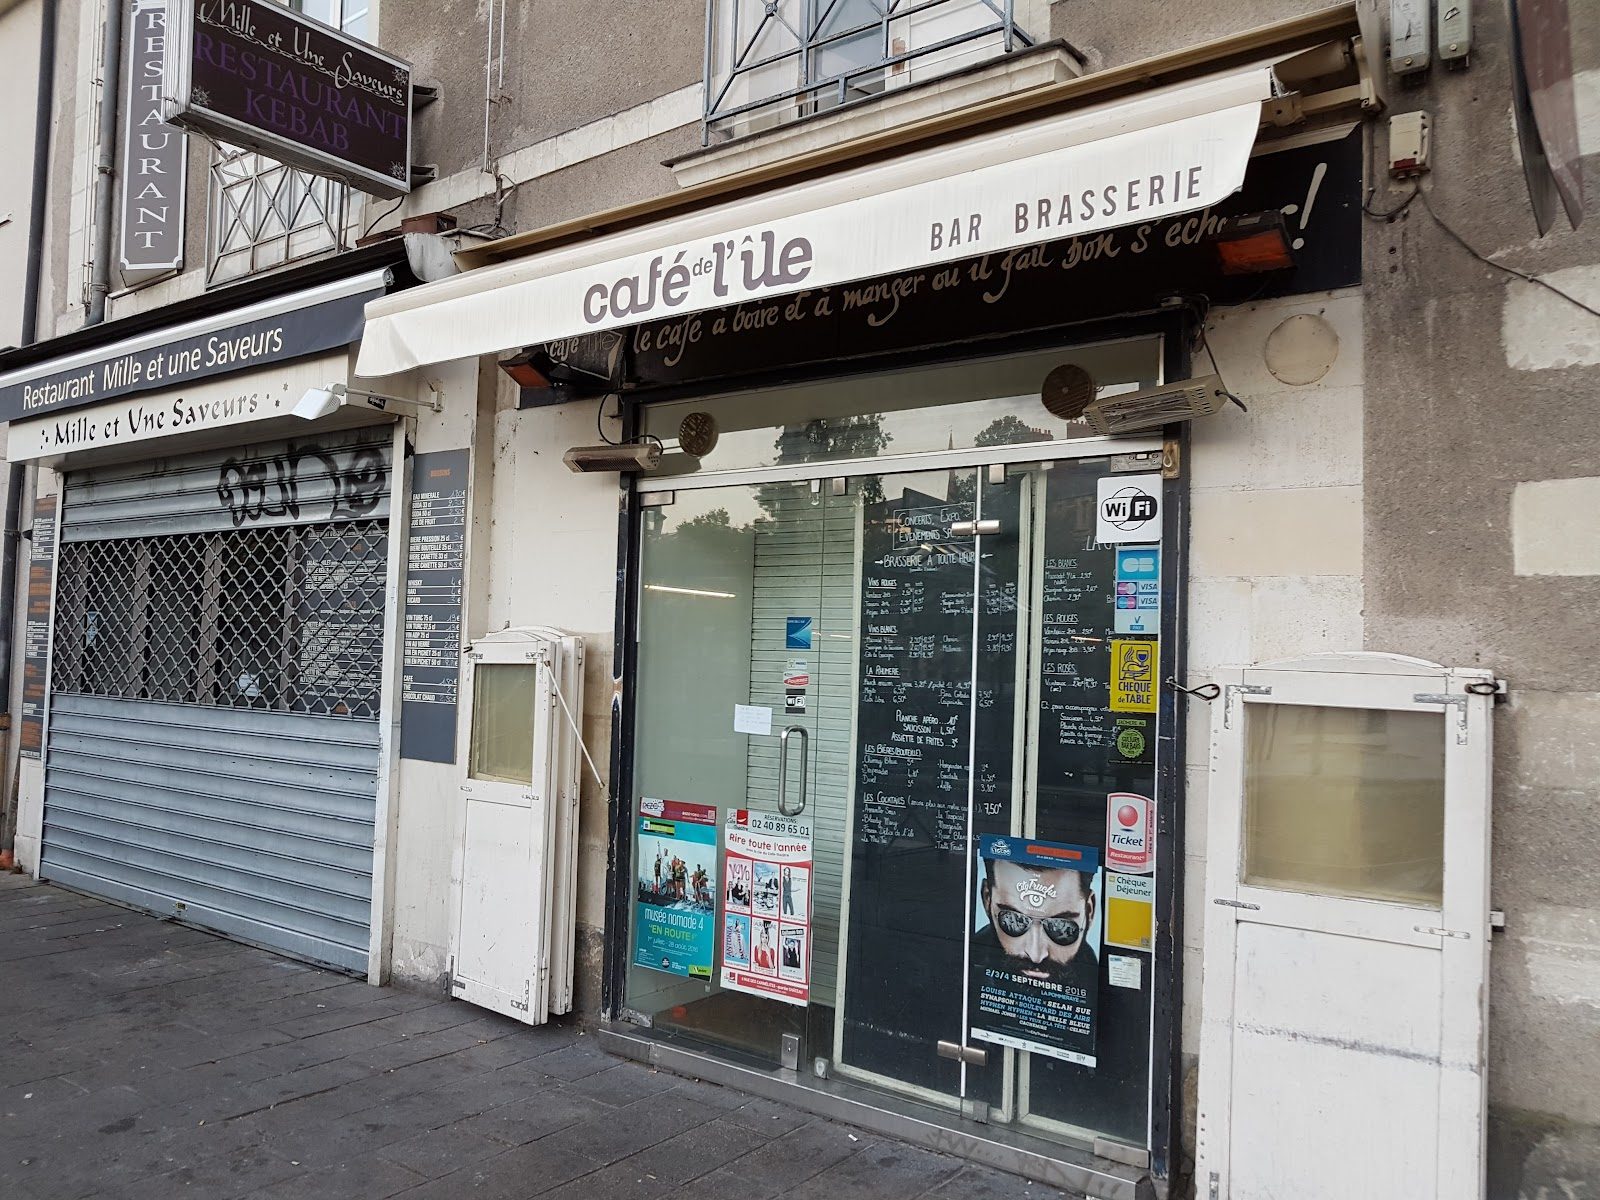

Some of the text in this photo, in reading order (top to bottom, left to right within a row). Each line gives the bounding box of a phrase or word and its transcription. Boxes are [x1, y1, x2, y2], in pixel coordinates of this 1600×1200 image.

[200, 0, 403, 99] Mille et Une Saveurs
[194, 31, 406, 140] RESTAURANT
[244, 87, 349, 150] KEBAB
[134, 13, 171, 249] RESTAURANT
[930, 166, 1202, 251] BAR BRASSERIE
[583, 250, 691, 324] café
[692, 257, 713, 276] de
[633, 325, 651, 354] le
[732, 300, 779, 332] boire
[785, 291, 812, 321] et
[843, 274, 925, 326] manger
[983, 243, 1054, 304] fait
[1062, 233, 1121, 270] bon
[23, 327, 283, 410] Restaurant Mille et une Saveurs
[54, 393, 258, 447] Mille et Une Saveurs
[884, 551, 976, 568] BRASSERIE A TOUTE HEUR
[1141, 583, 1158, 591] VISA
[1141, 597, 1158, 605] VISA
[1118, 682, 1152, 693] CHEQUE
[1125, 694, 1152, 704] TABLE
[896, 709, 918, 723] PLANCHE
[903, 723, 932, 734] SAUCISSON
[891, 732, 915, 743] ASSIETTE
[917, 736, 924, 744] DE
[926, 737, 945, 747] FRITES
[864, 744, 875, 753] LES
[864, 792, 874, 802] LES
[752, 819, 810, 836] 02 40 89 65 01
[730, 833, 807, 852] Rire toute l'année
[1112, 833, 1144, 847] Ticket
[1016, 878, 1057, 898] City Trucks
[1116, 875, 1147, 888] Chèque
[1116, 885, 1152, 897] Déjeuner
[644, 907, 704, 932] musée nomade 4
[664, 928, 691, 941] ROUTE
[985, 969, 1087, 997] 2/3/4 SEPTEMBRE 2016
[981, 986, 1092, 1016] LOUISE ATTAQUE SELAH SUE
[1018, 1002, 1057, 1016] BOULEVARD
[1058, 1010, 1073, 1019] DES
[1036, 1012, 1046, 1020] LA
[1048, 1015, 1068, 1025] BELLE
[1069, 1020, 1091, 1030] BLEUE
